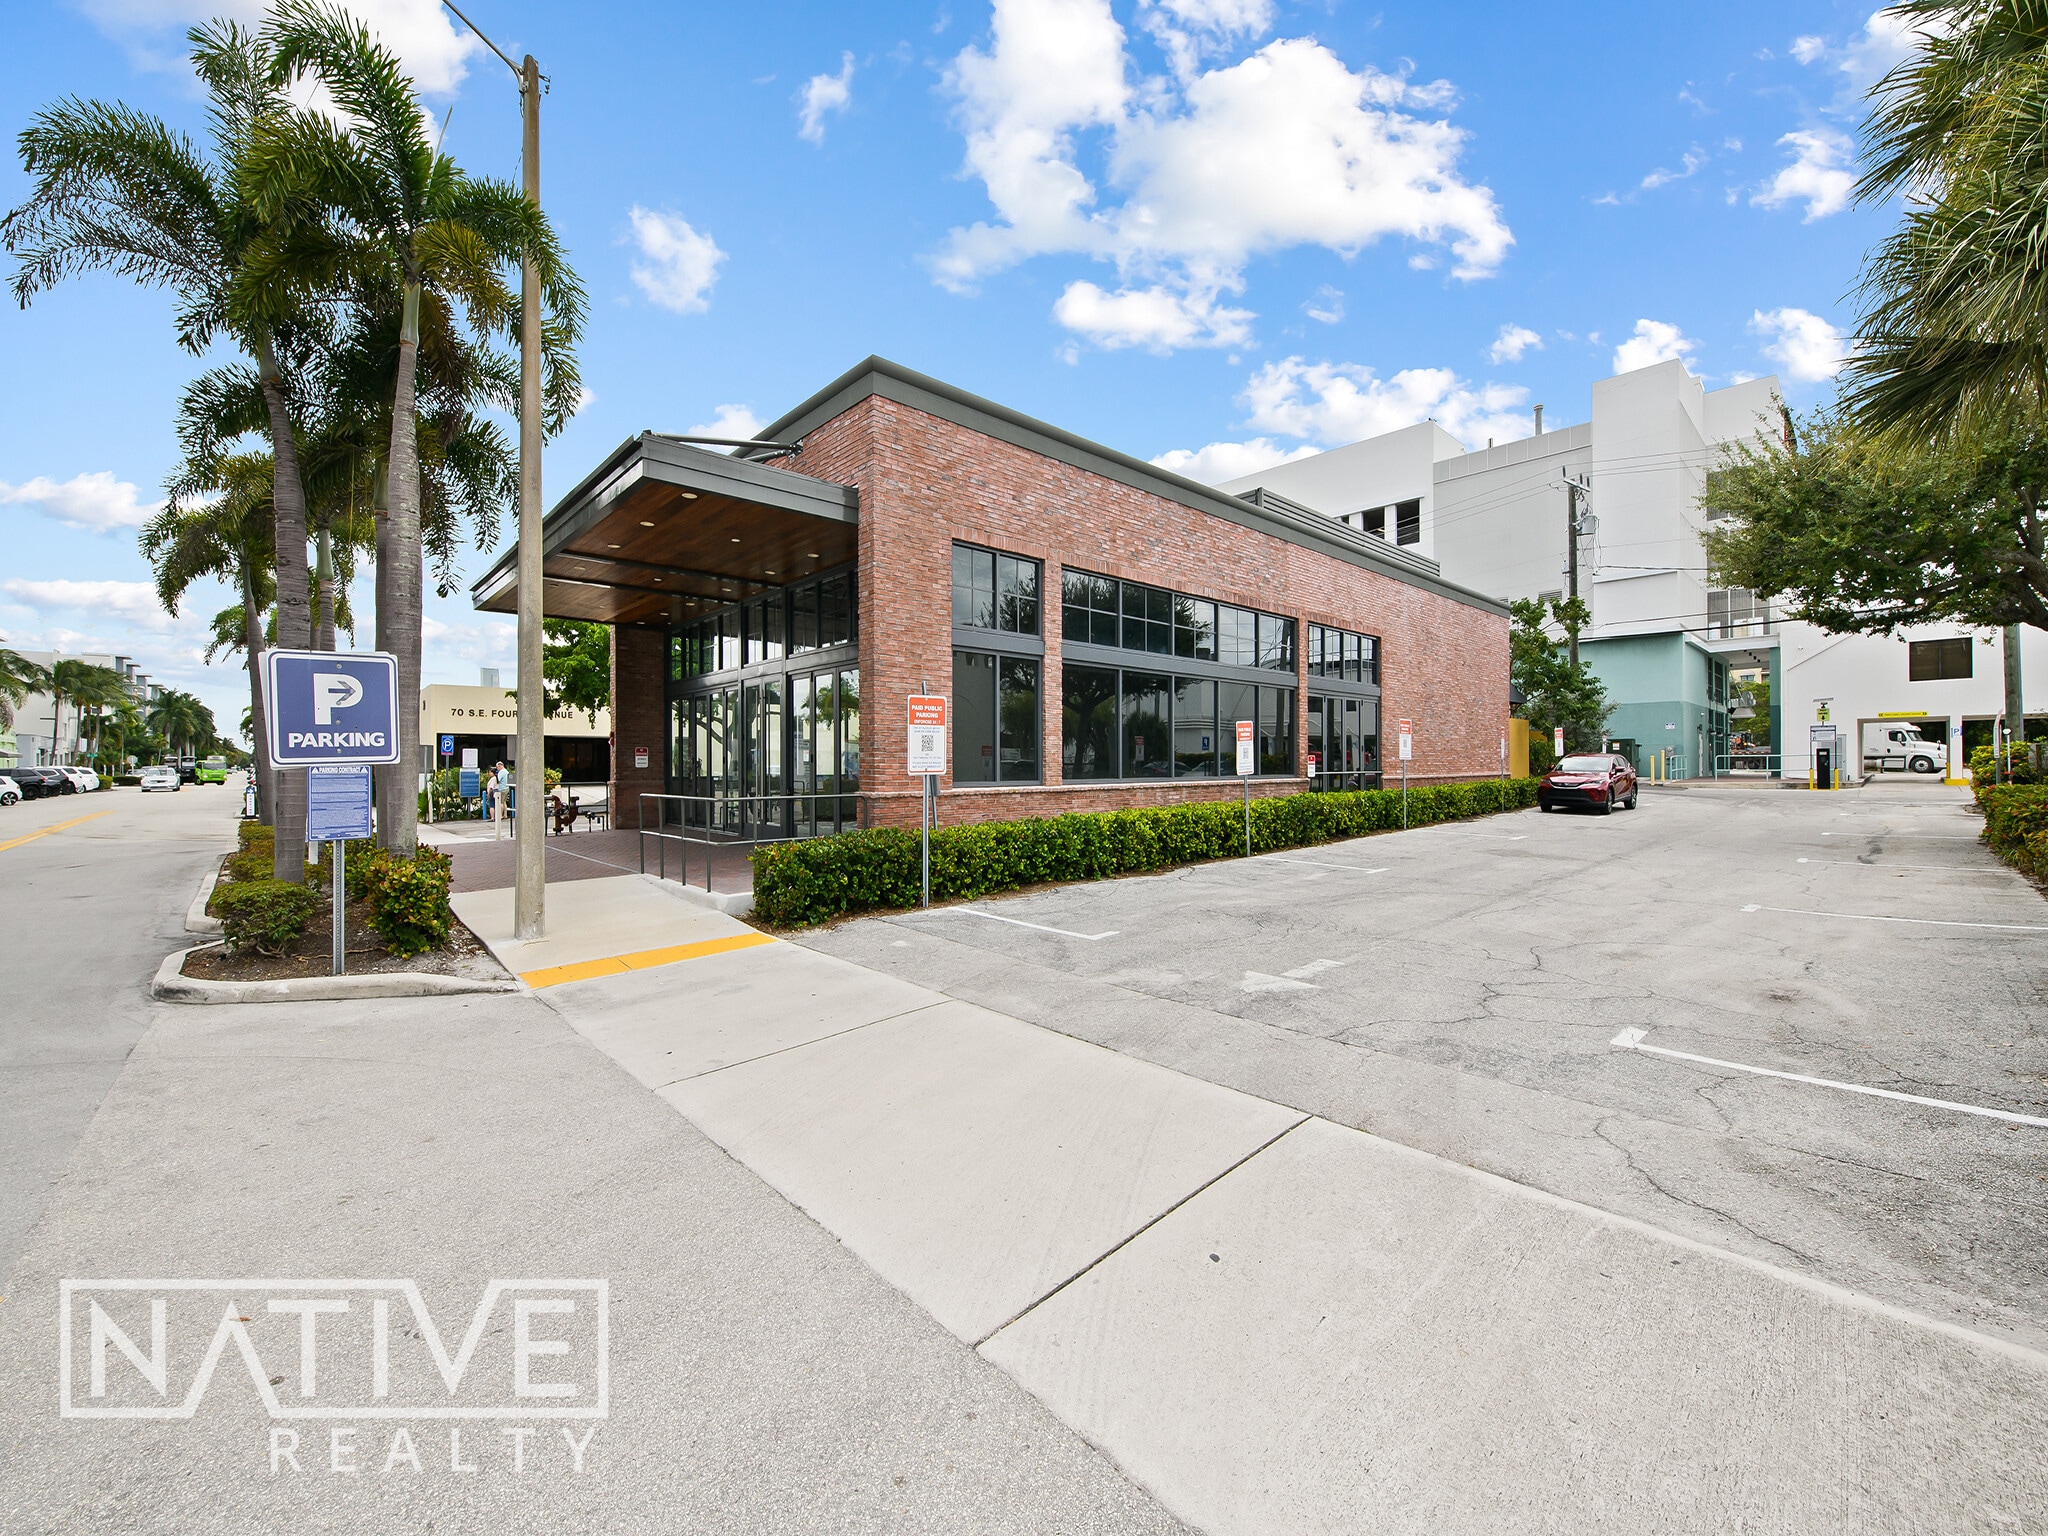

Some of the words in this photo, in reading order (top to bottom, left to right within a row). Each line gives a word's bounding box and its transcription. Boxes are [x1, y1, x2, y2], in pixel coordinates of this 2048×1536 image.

[313, 673, 364, 725] P
[451, 708, 464, 717] 70
[468, 709, 488, 718] S.E.
[491, 710, 518, 719] FOUR
[288, 732, 385, 748] PARKING
